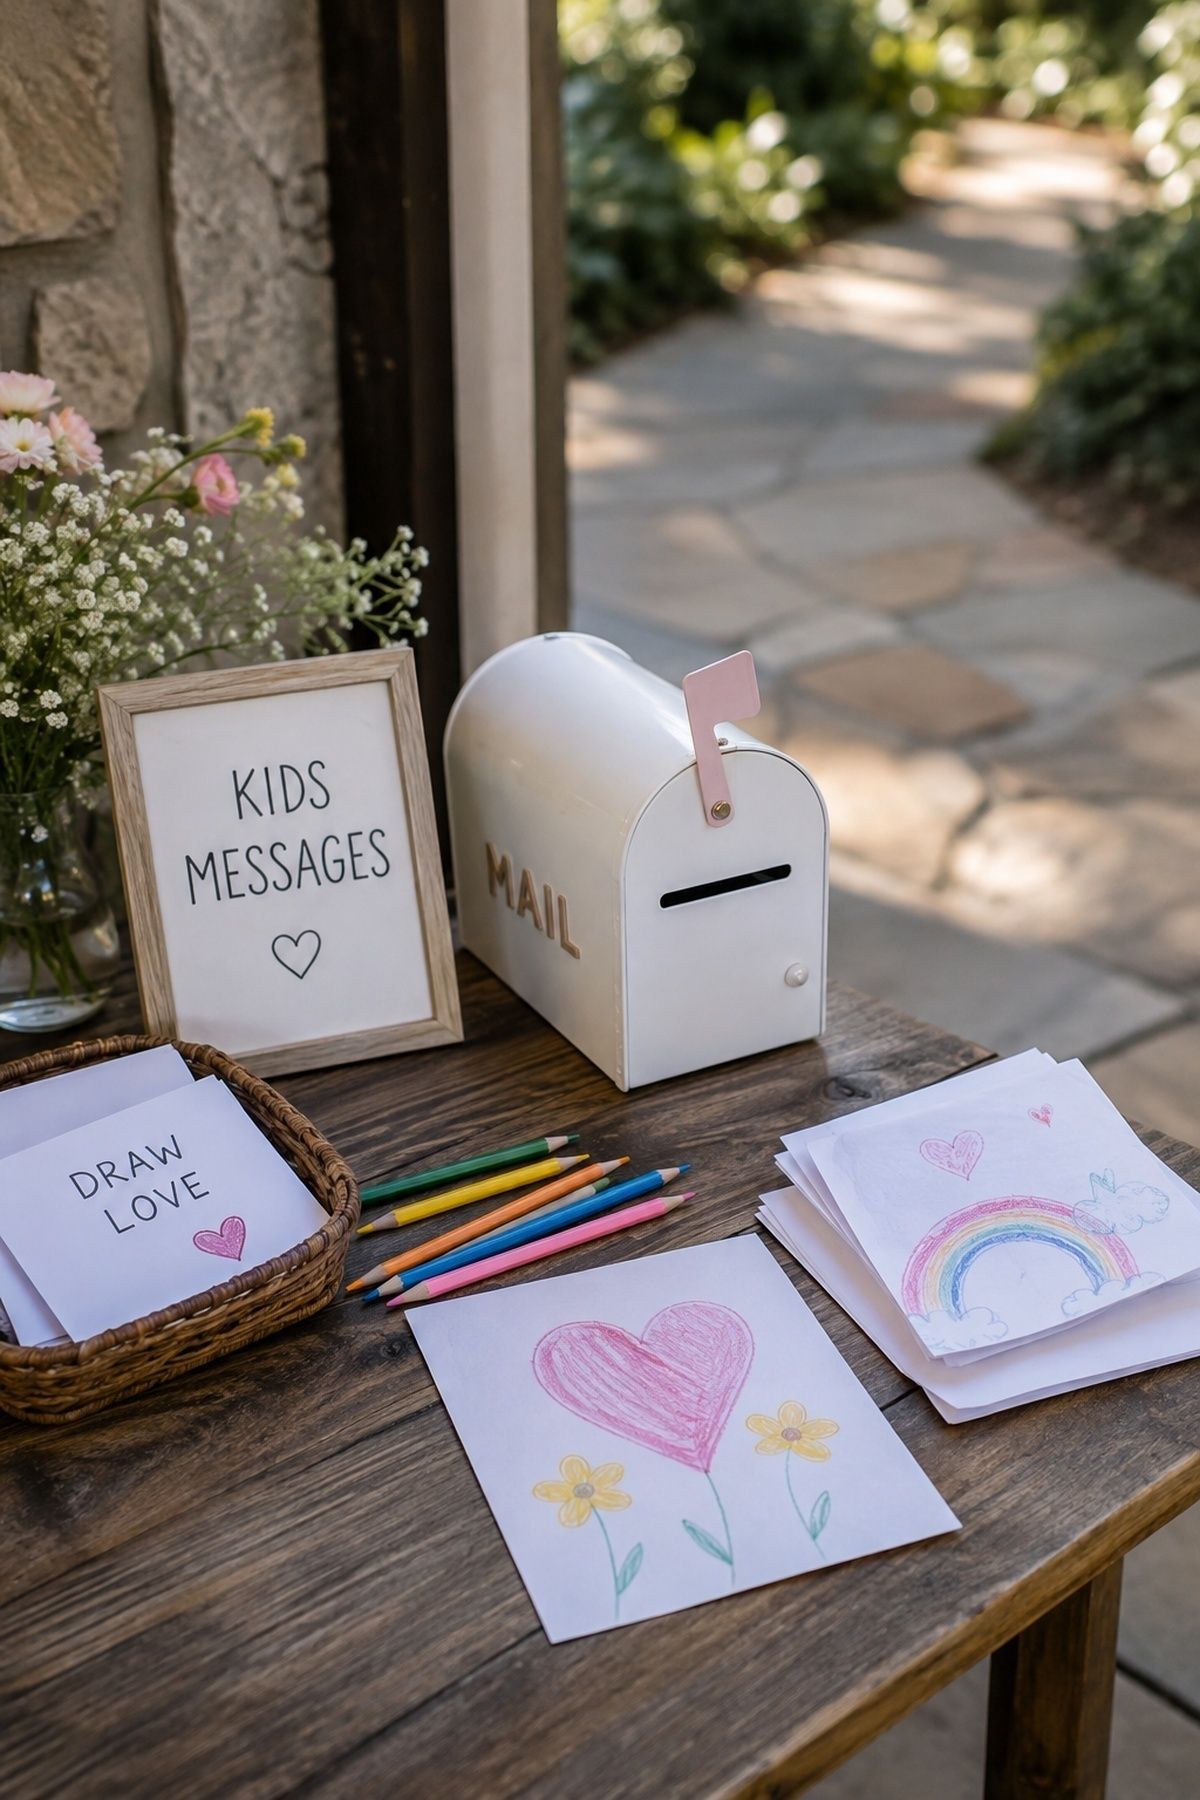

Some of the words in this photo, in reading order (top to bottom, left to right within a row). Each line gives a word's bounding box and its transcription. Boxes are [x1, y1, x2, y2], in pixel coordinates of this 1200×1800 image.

[231, 760, 330, 821] KIDS
[184, 828, 391, 906] MESSAGES
[484, 841, 581, 960] MAIL
[68, 1133, 183, 1201] DRAW
[103, 1171, 210, 1235] LOVE
